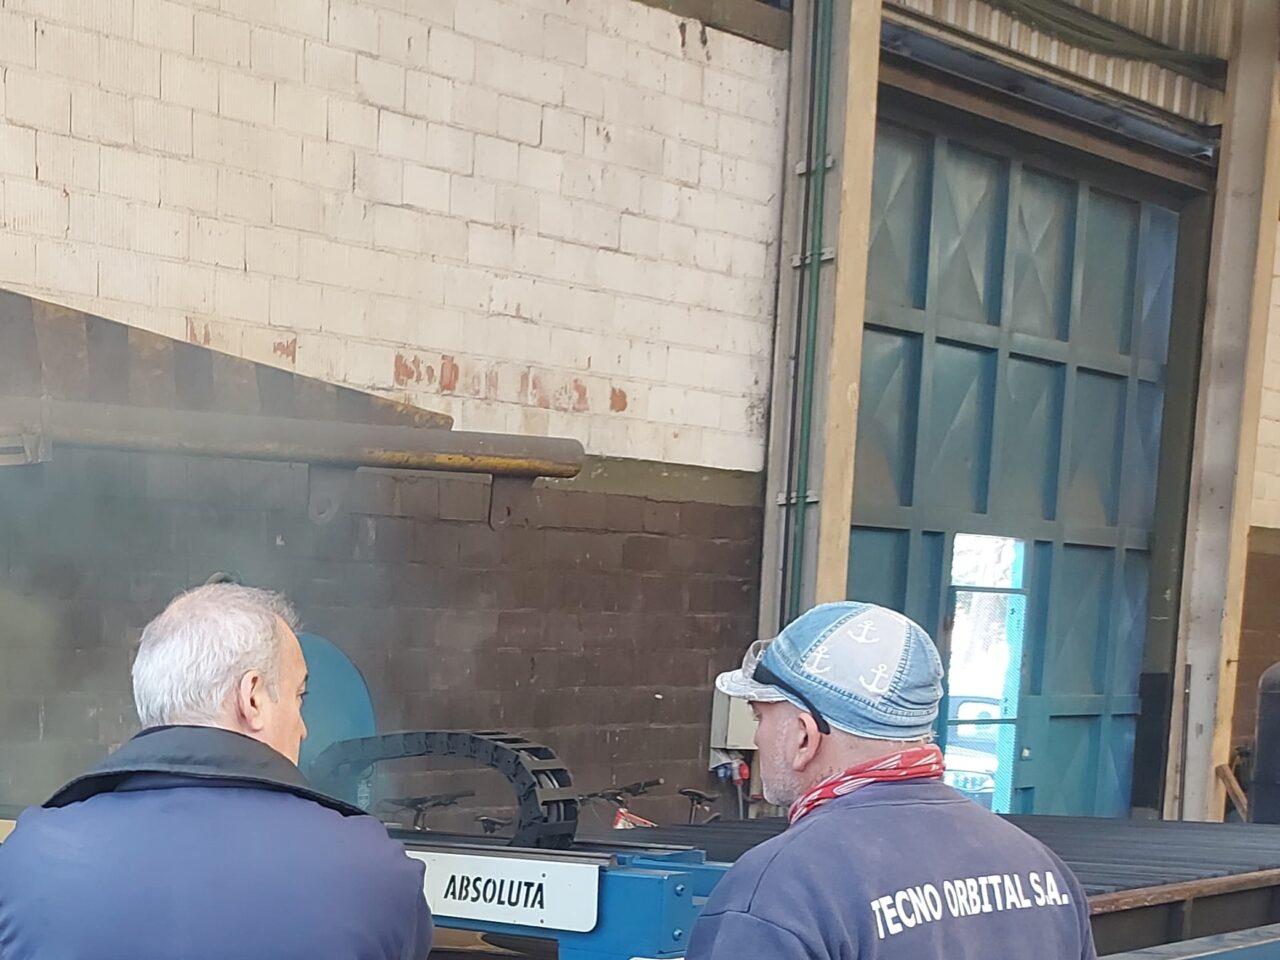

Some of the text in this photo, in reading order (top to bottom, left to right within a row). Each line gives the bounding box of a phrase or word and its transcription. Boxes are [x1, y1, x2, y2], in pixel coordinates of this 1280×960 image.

[443, 874, 545, 909] ABSOLUTA
[870, 870, 1070, 939] TECNO ORBITAL S.A.
